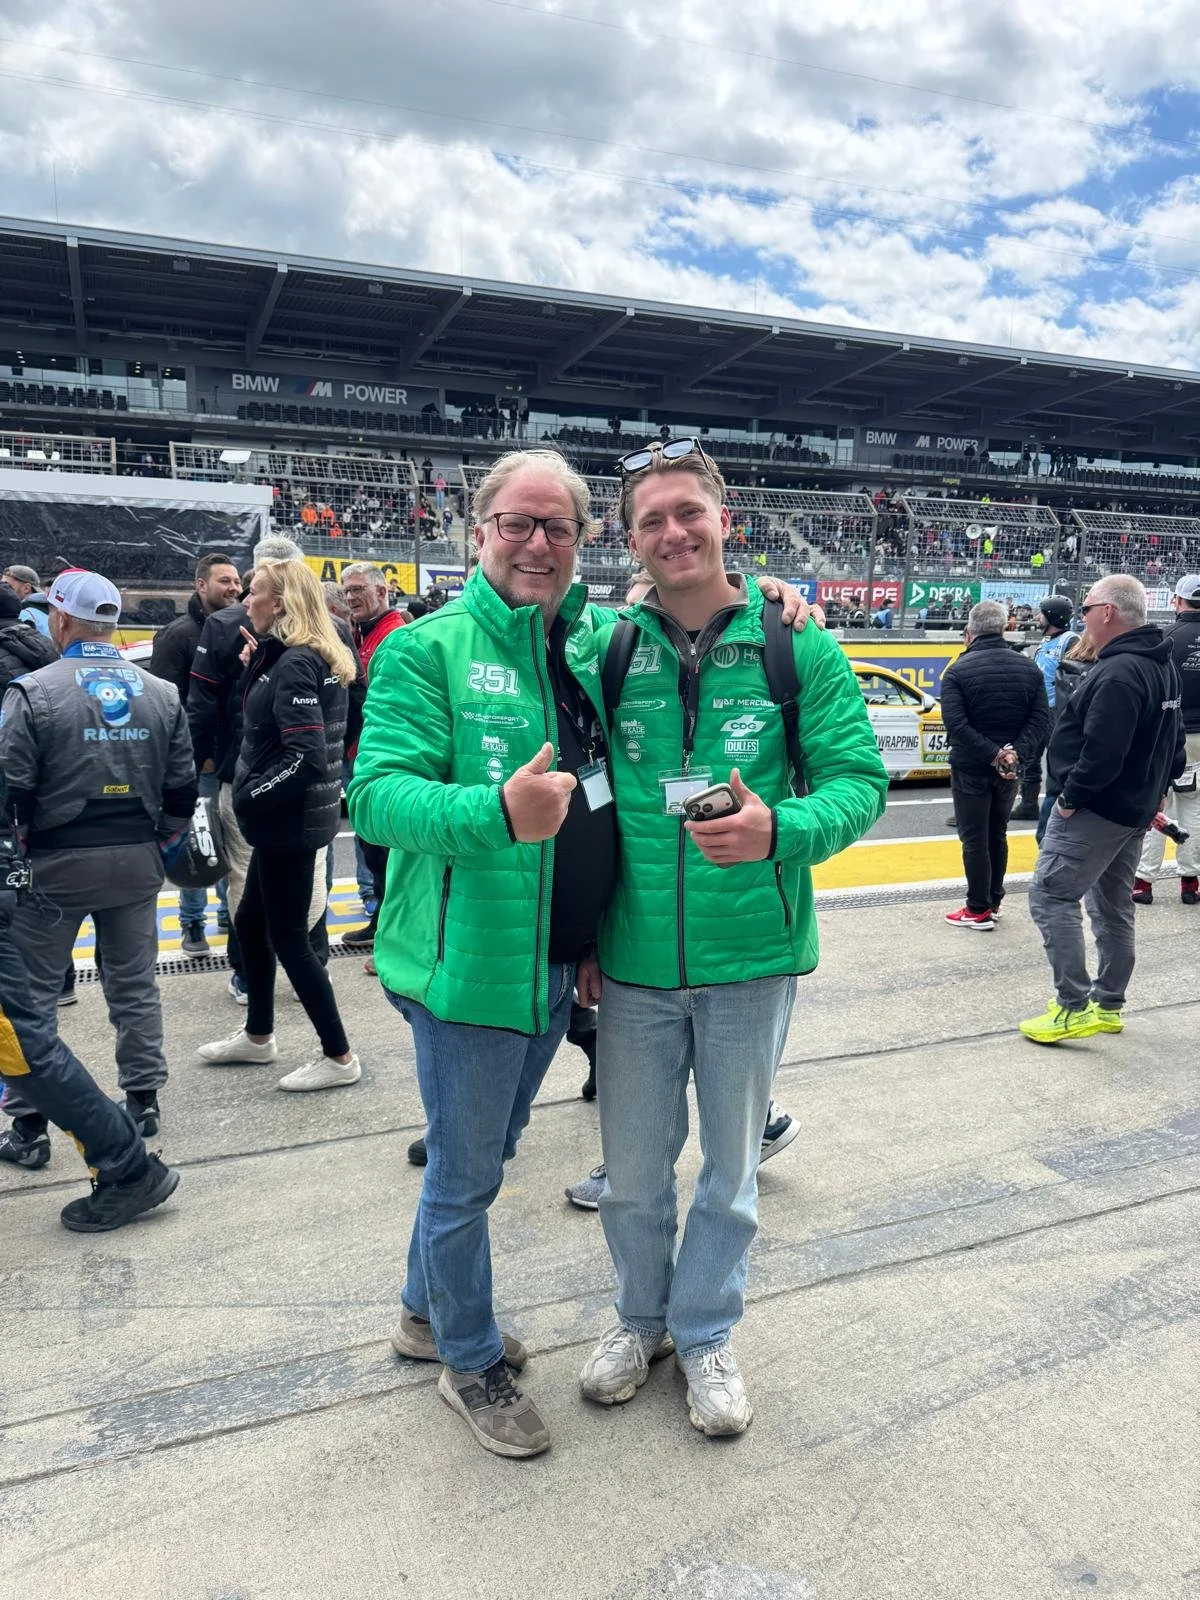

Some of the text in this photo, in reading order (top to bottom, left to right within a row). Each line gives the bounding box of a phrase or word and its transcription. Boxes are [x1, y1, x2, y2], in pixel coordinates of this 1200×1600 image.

[232, 374, 408, 405] BMW M POWER
[866, 431, 898, 446] BMW
[321, 560, 399, 584] AC
[821, 587, 898, 601] WEMPE
[929, 588, 972, 602] DEKRA
[627, 644, 662, 676] 51
[468, 660, 520, 697] 251
[292, 697, 318, 706] Ansys
[730, 722, 757, 730] CDG
[84, 727, 151, 742] RACING
[727, 741, 758, 752] DULLES
[928, 734, 951, 751] 454
